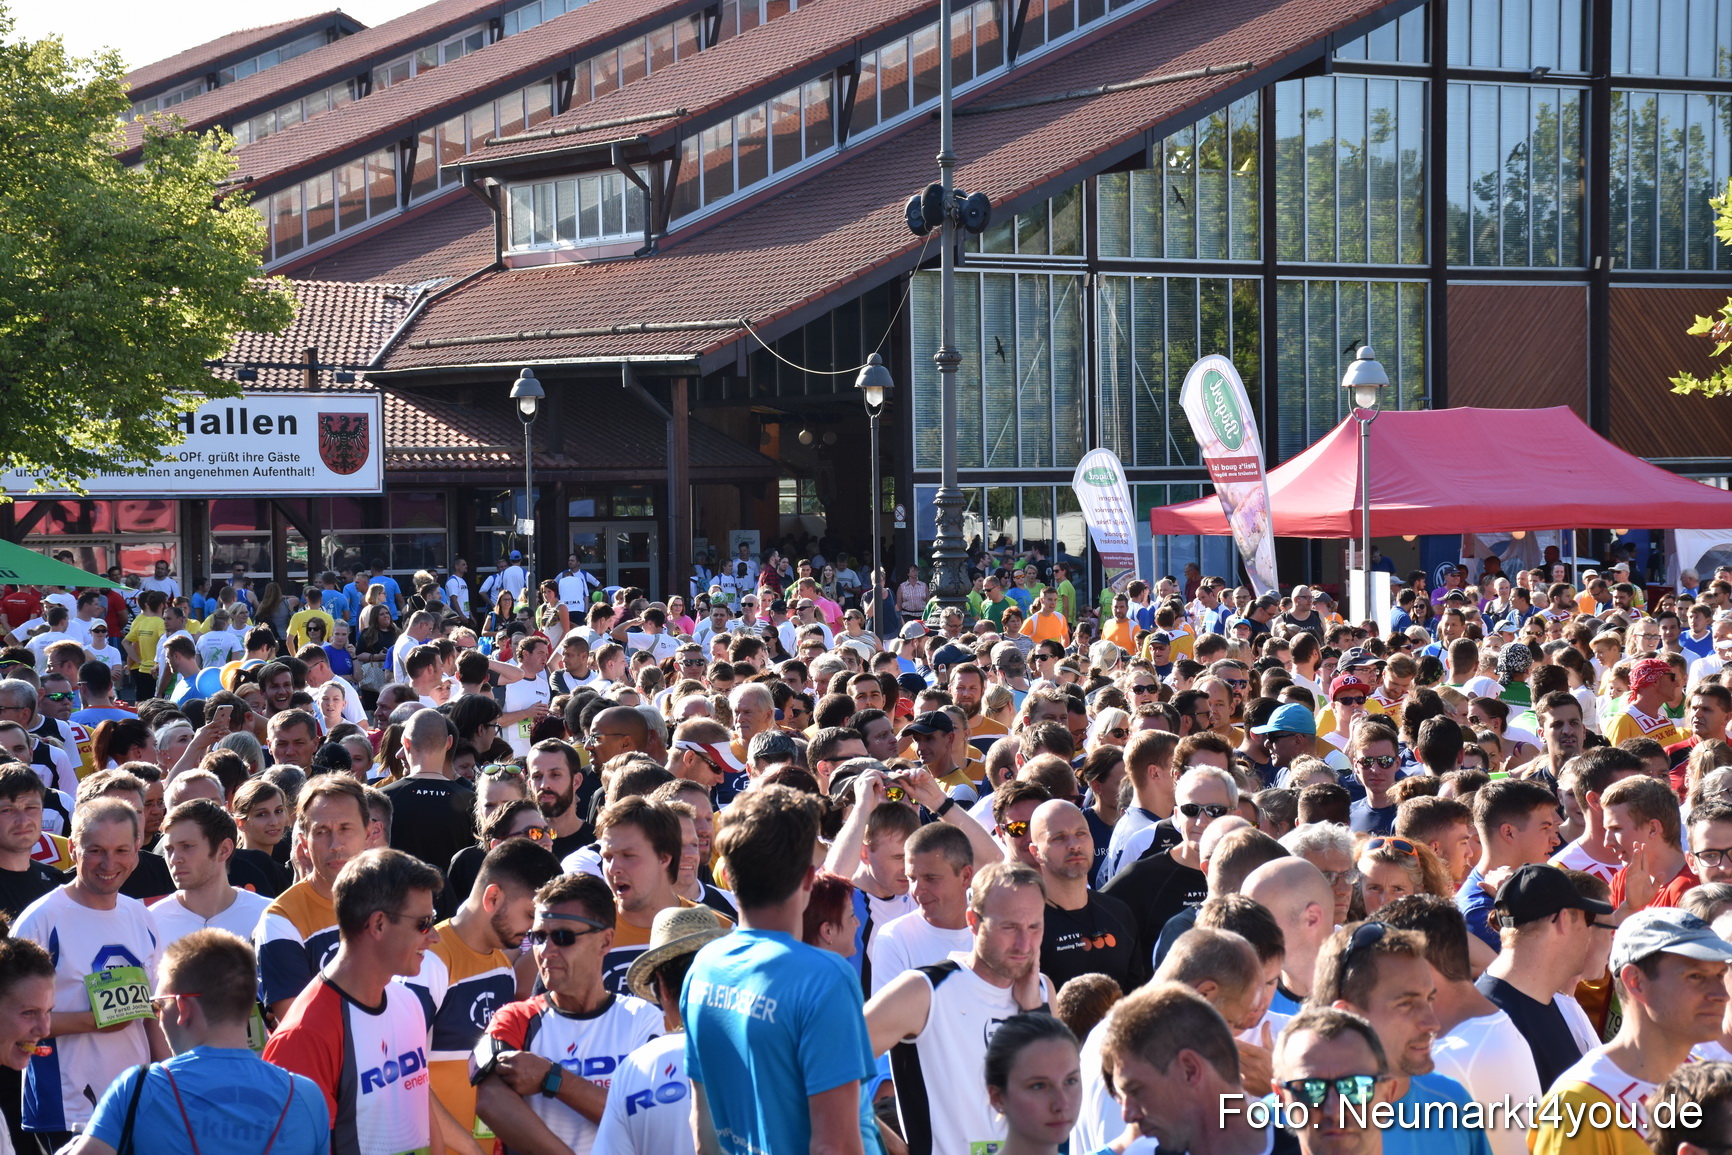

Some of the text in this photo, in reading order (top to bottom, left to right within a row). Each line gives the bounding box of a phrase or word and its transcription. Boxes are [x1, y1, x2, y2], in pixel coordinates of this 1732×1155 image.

[172, 407, 298, 435] Hallen
[179, 452, 204, 462] OPf.
[208, 452, 239, 465] grüßt
[242, 452, 264, 462] ihre
[268, 452, 300, 462] Gäste
[174, 466, 249, 479] angenehmen
[252, 466, 315, 477] Aufenthalt!
[416, 789, 447, 797] APTIV
[1058, 932, 1081, 942] APTIV
[100, 984, 150, 1011] 2020
